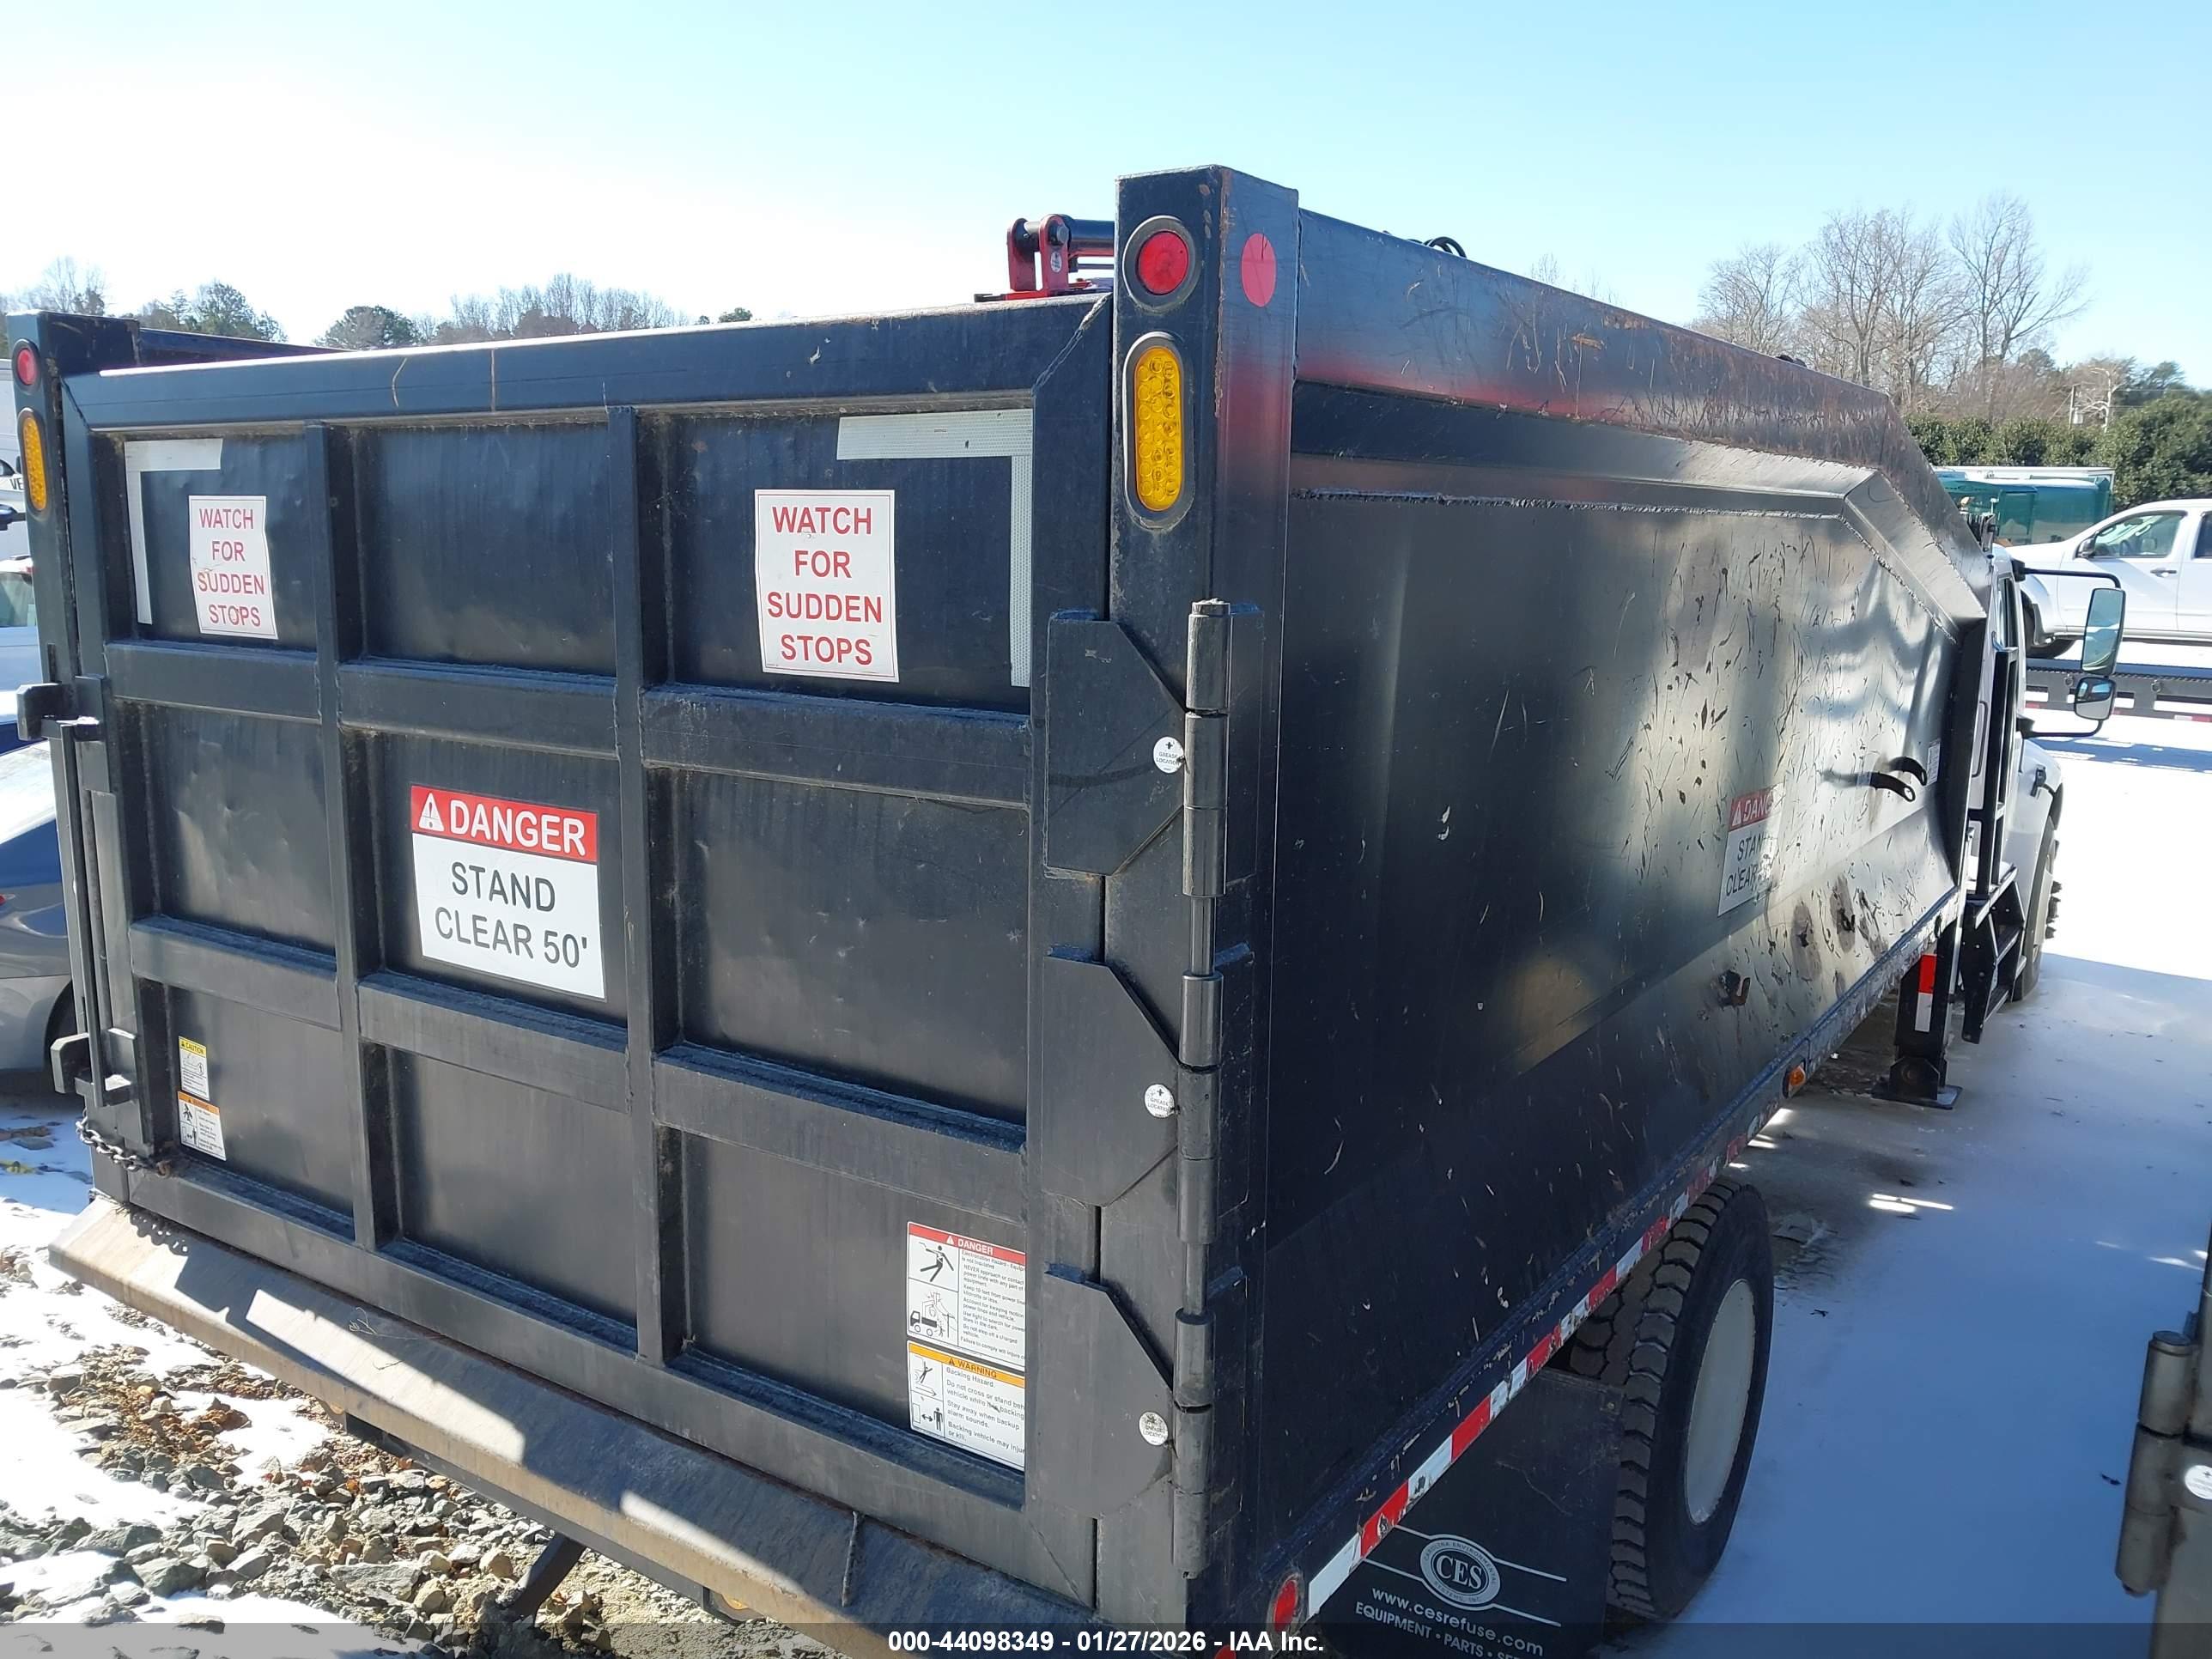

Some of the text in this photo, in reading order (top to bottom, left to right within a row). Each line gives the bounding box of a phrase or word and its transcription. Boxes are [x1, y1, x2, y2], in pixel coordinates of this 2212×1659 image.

[199, 508, 254, 530] WATCH
[772, 507, 872, 535] WATCH
[212, 541, 246, 562] FOR
[794, 550, 852, 579] FOR
[197, 572, 265, 595] SUDDEN
[209, 605, 261, 627] STOPS
[767, 592, 882, 623] SUDDEN
[781, 635, 872, 665] STOPS
[450, 799, 586, 856] DANGER
[452, 862, 556, 912] STAND
[434, 907, 587, 968] CLEAR 50'
[957, 1238, 994, 1255] DANGER
[964, 1264, 979, 1273] NEVER
[963, 1297, 981, 1306] Account
[946, 1366, 970, 1381] Backing
[958, 1359, 997, 1377] WARNING
[946, 1389, 986, 1406] vehicle while
[968, 1388, 985, 1397] cross
[994, 1395, 1012, 1406] stand
[947, 1408, 963, 1419] alarm
[947, 1400, 960, 1411] Stay
[962, 1407, 977, 1416] away
[979, 1412, 995, 1421] when
[997, 1417, 1019, 1431] backup
[1000, 1407, 1024, 1420] backing
[948, 1421, 971, 1437] Backing
[974, 1431, 995, 1443] vehicle
[996, 1440, 1009, 1449] may
[1437, 1555, 1482, 1589] CES
[1355, 1601, 1484, 1658] EQUIPMENT PARTS
[1372, 1588, 1544, 1656] www.cesrefuse.com
